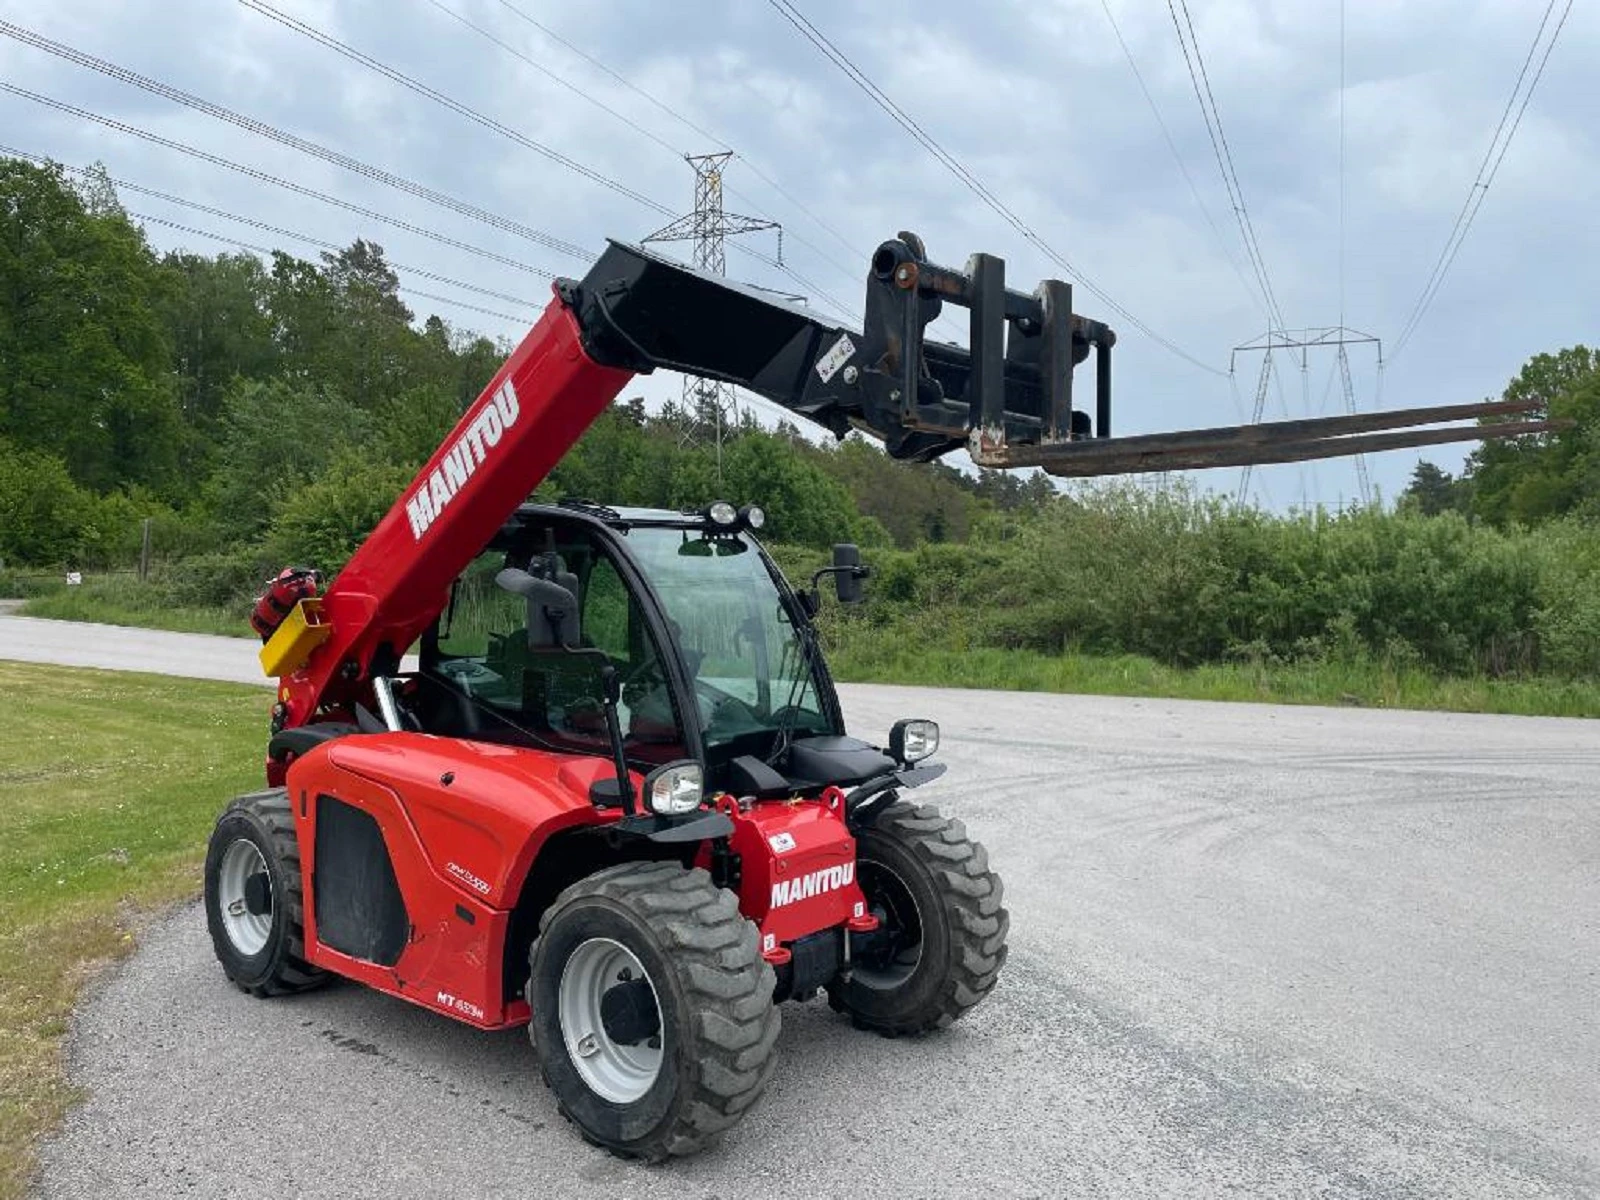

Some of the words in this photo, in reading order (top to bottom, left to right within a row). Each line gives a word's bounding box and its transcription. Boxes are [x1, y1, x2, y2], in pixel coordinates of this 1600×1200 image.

[406, 374, 520, 540] MANITOU
[770, 862, 854, 910] MANITOU
[437, 991, 455, 1007] MT
